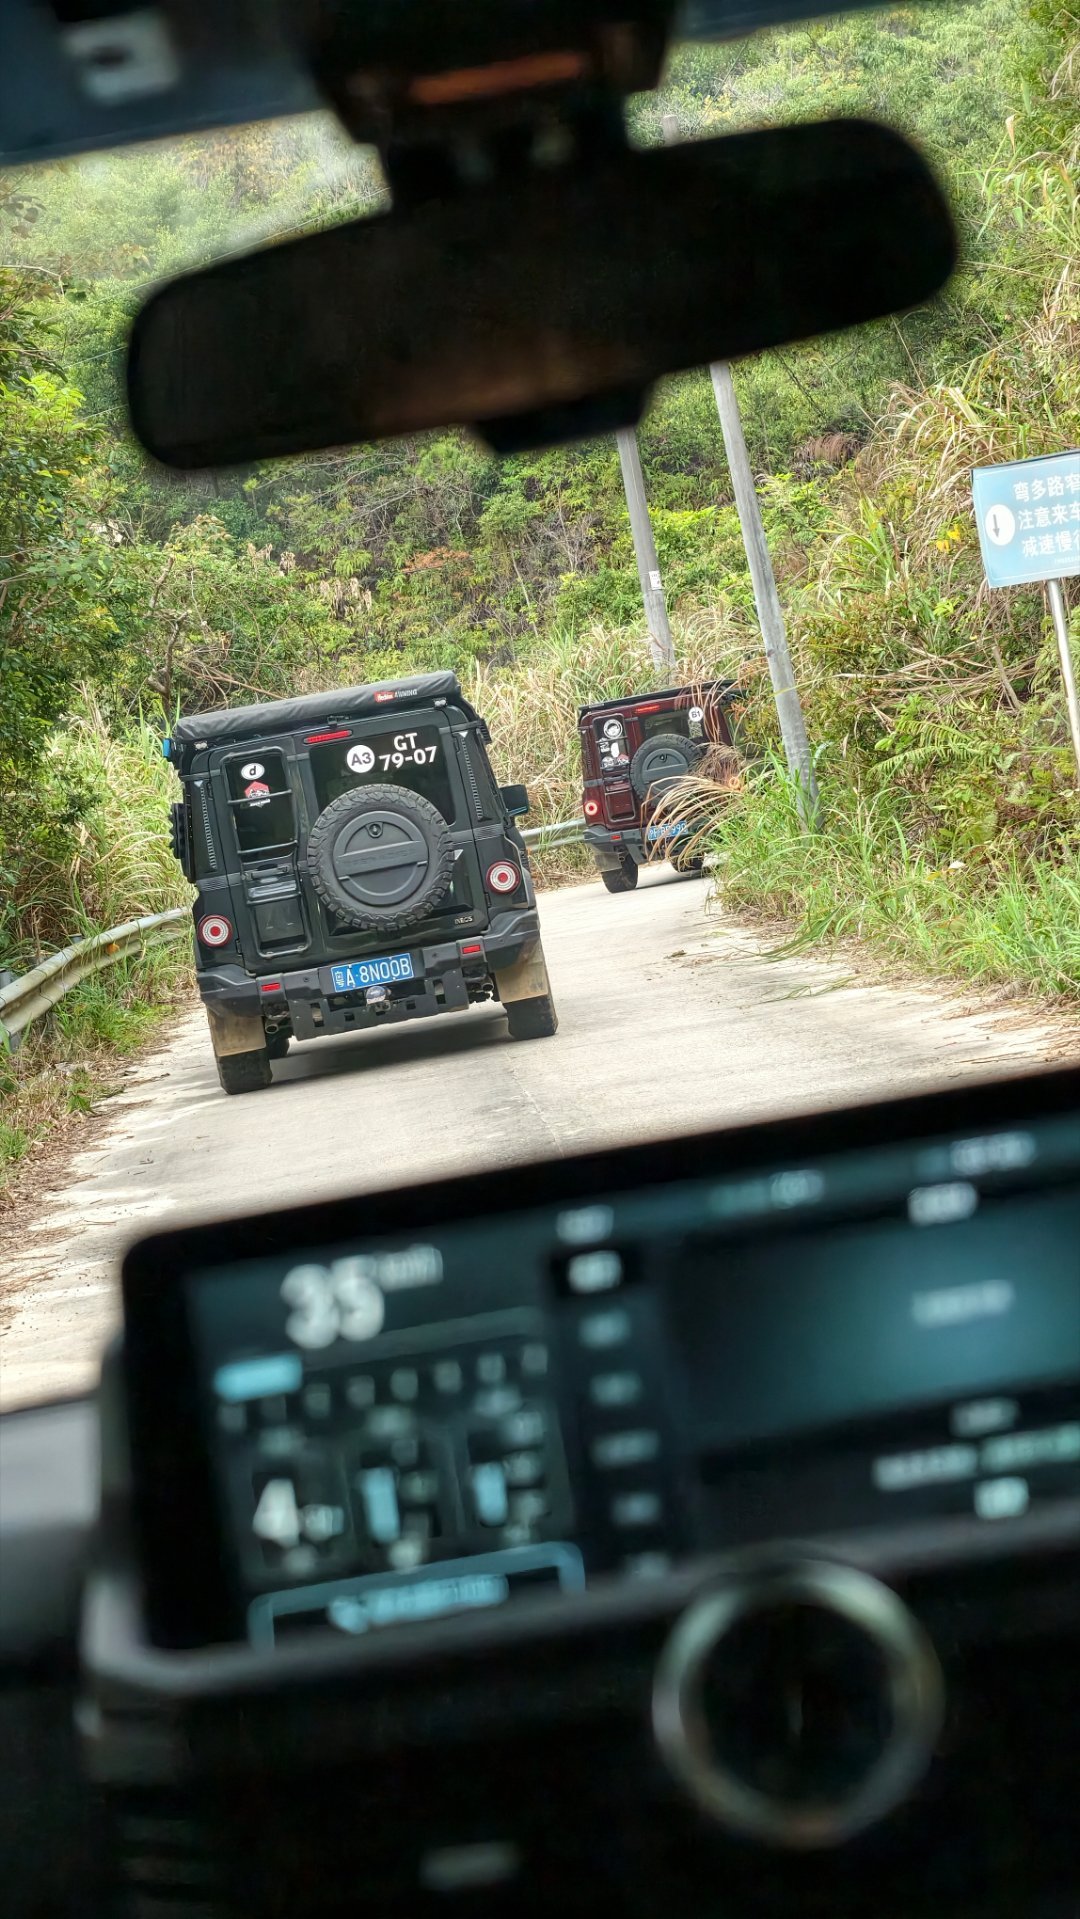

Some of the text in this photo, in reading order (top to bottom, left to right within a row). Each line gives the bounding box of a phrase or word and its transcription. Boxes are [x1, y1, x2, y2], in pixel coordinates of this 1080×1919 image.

[1013, 473, 1080, 502] 弯多路窄
[1018, 500, 1080, 531] 注意来车
[393, 732, 418, 752] GT
[249, 765, 257, 776] d
[351, 751, 373, 767] A3
[378, 745, 438, 772] 79-07
[280, 1256, 385, 1349] 35
